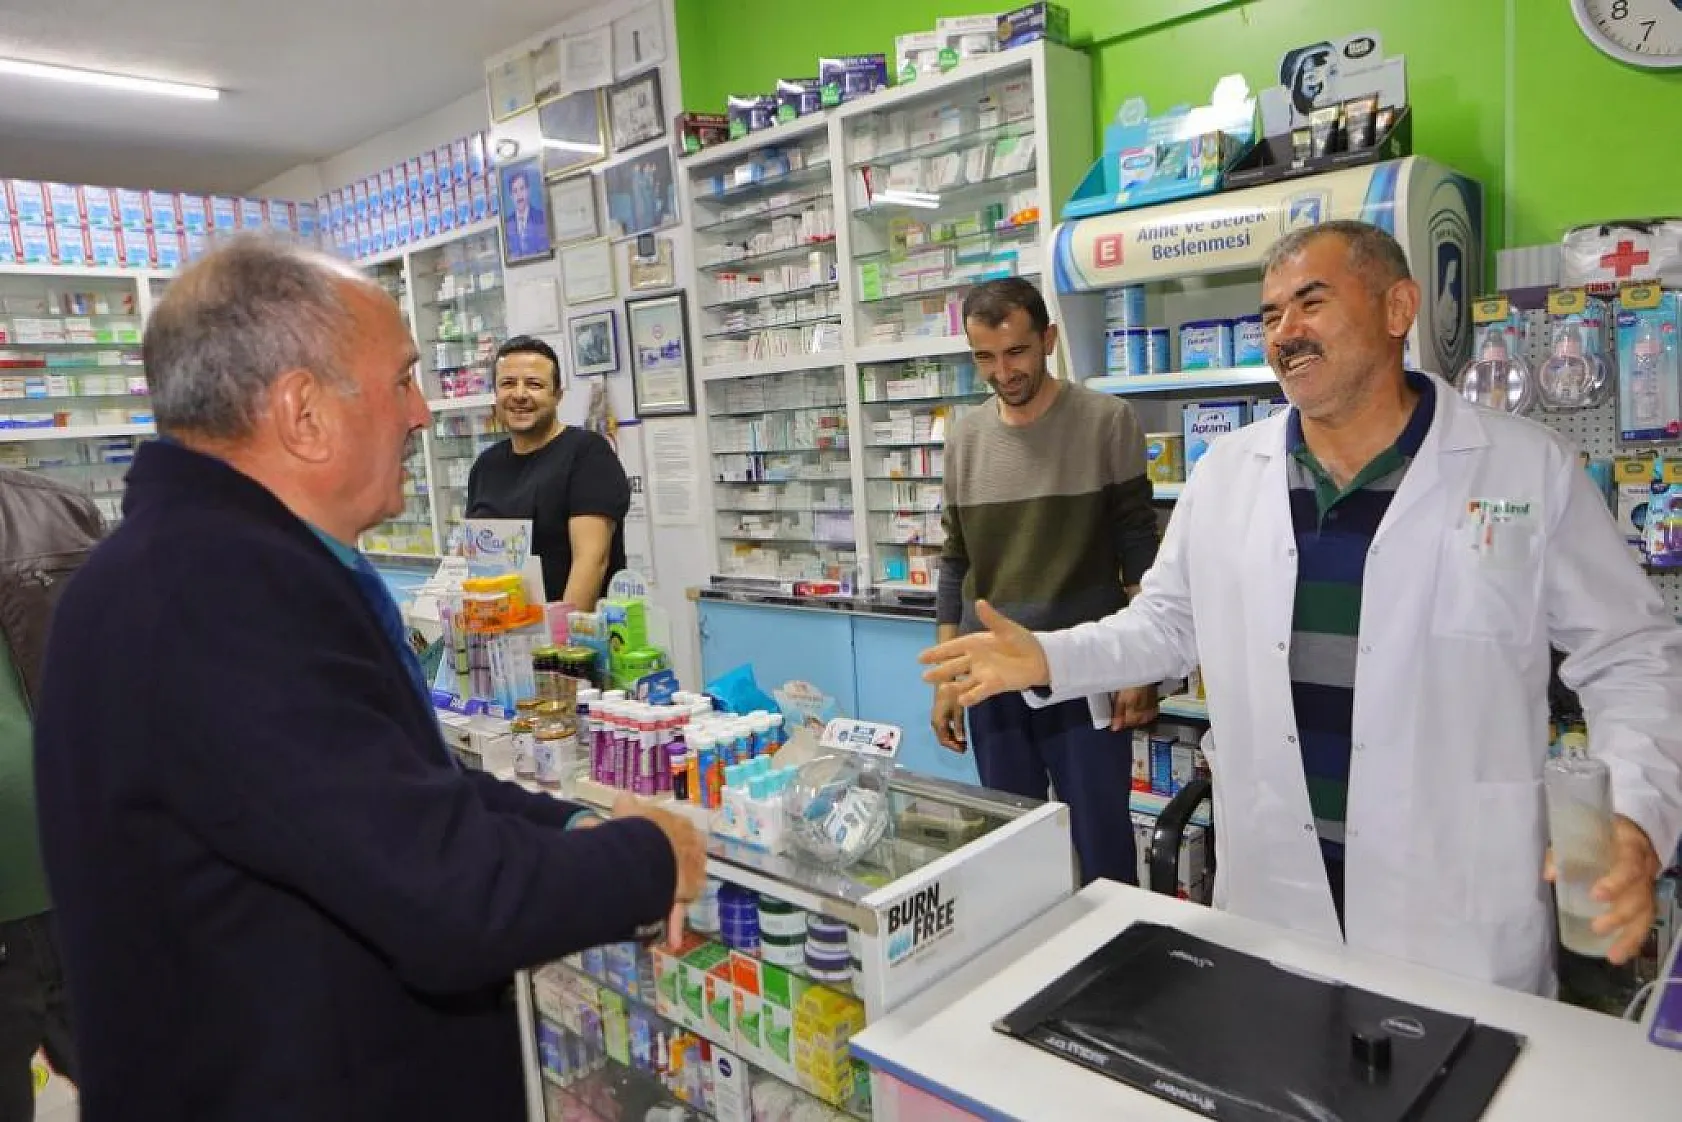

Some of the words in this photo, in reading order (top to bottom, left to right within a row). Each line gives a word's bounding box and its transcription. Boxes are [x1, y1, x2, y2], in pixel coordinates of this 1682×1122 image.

[1612, 0, 1628, 20] 8
[1640, 20, 1656, 41] 7
[1137, 223, 1179, 243] Anne
[1185, 220, 1205, 233] ve
[1152, 229, 1251, 261] Beslenmesi
[1191, 421, 1232, 435] Aptamil
[888, 881, 940, 935] BURN
[913, 897, 955, 945] FREE
